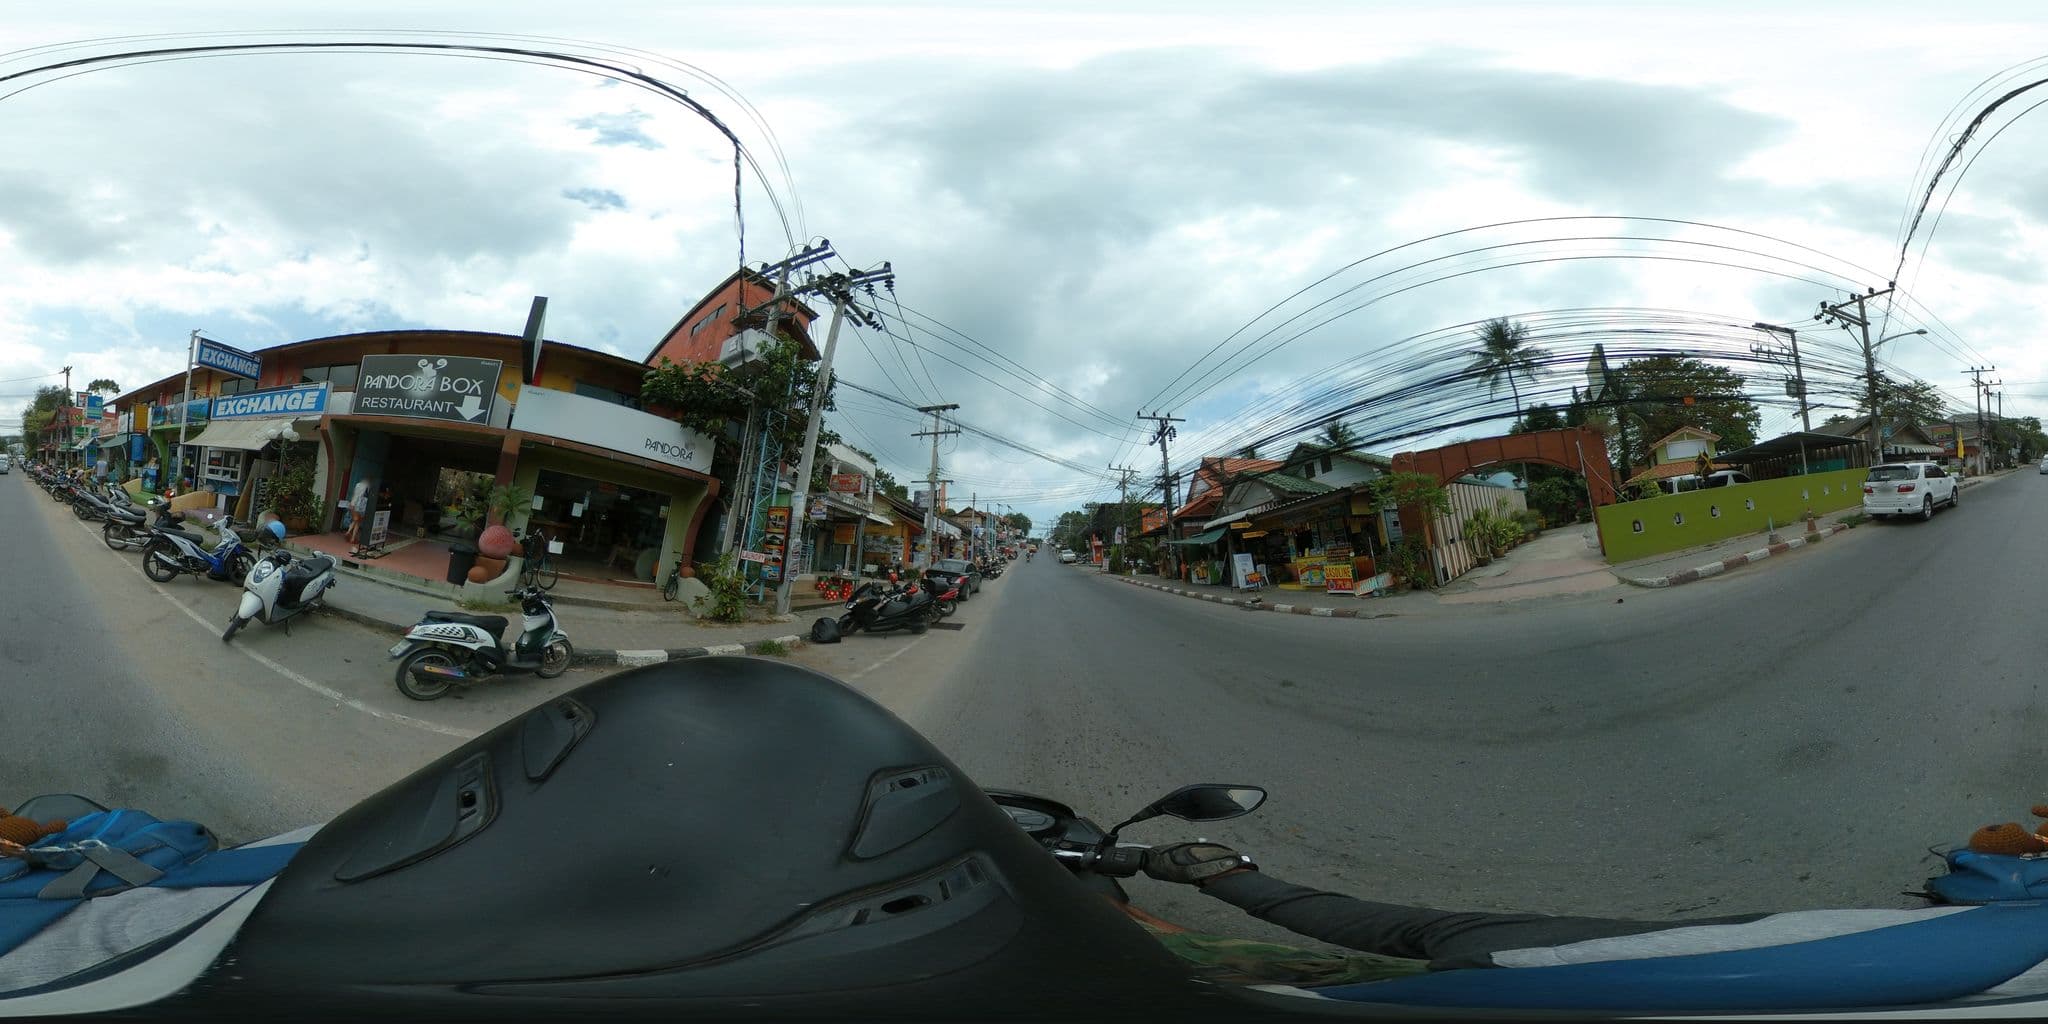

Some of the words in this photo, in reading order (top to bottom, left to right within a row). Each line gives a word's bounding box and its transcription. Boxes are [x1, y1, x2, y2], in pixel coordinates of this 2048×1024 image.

[202, 348, 260, 376] EXCHANGE
[363, 374, 436, 392] PANDORA
[440, 376, 484, 395] BOX
[215, 391, 320, 417] EXCHANGE
[361, 396, 454, 414] RESTAURANT
[644, 438, 693, 461] PANDORA
